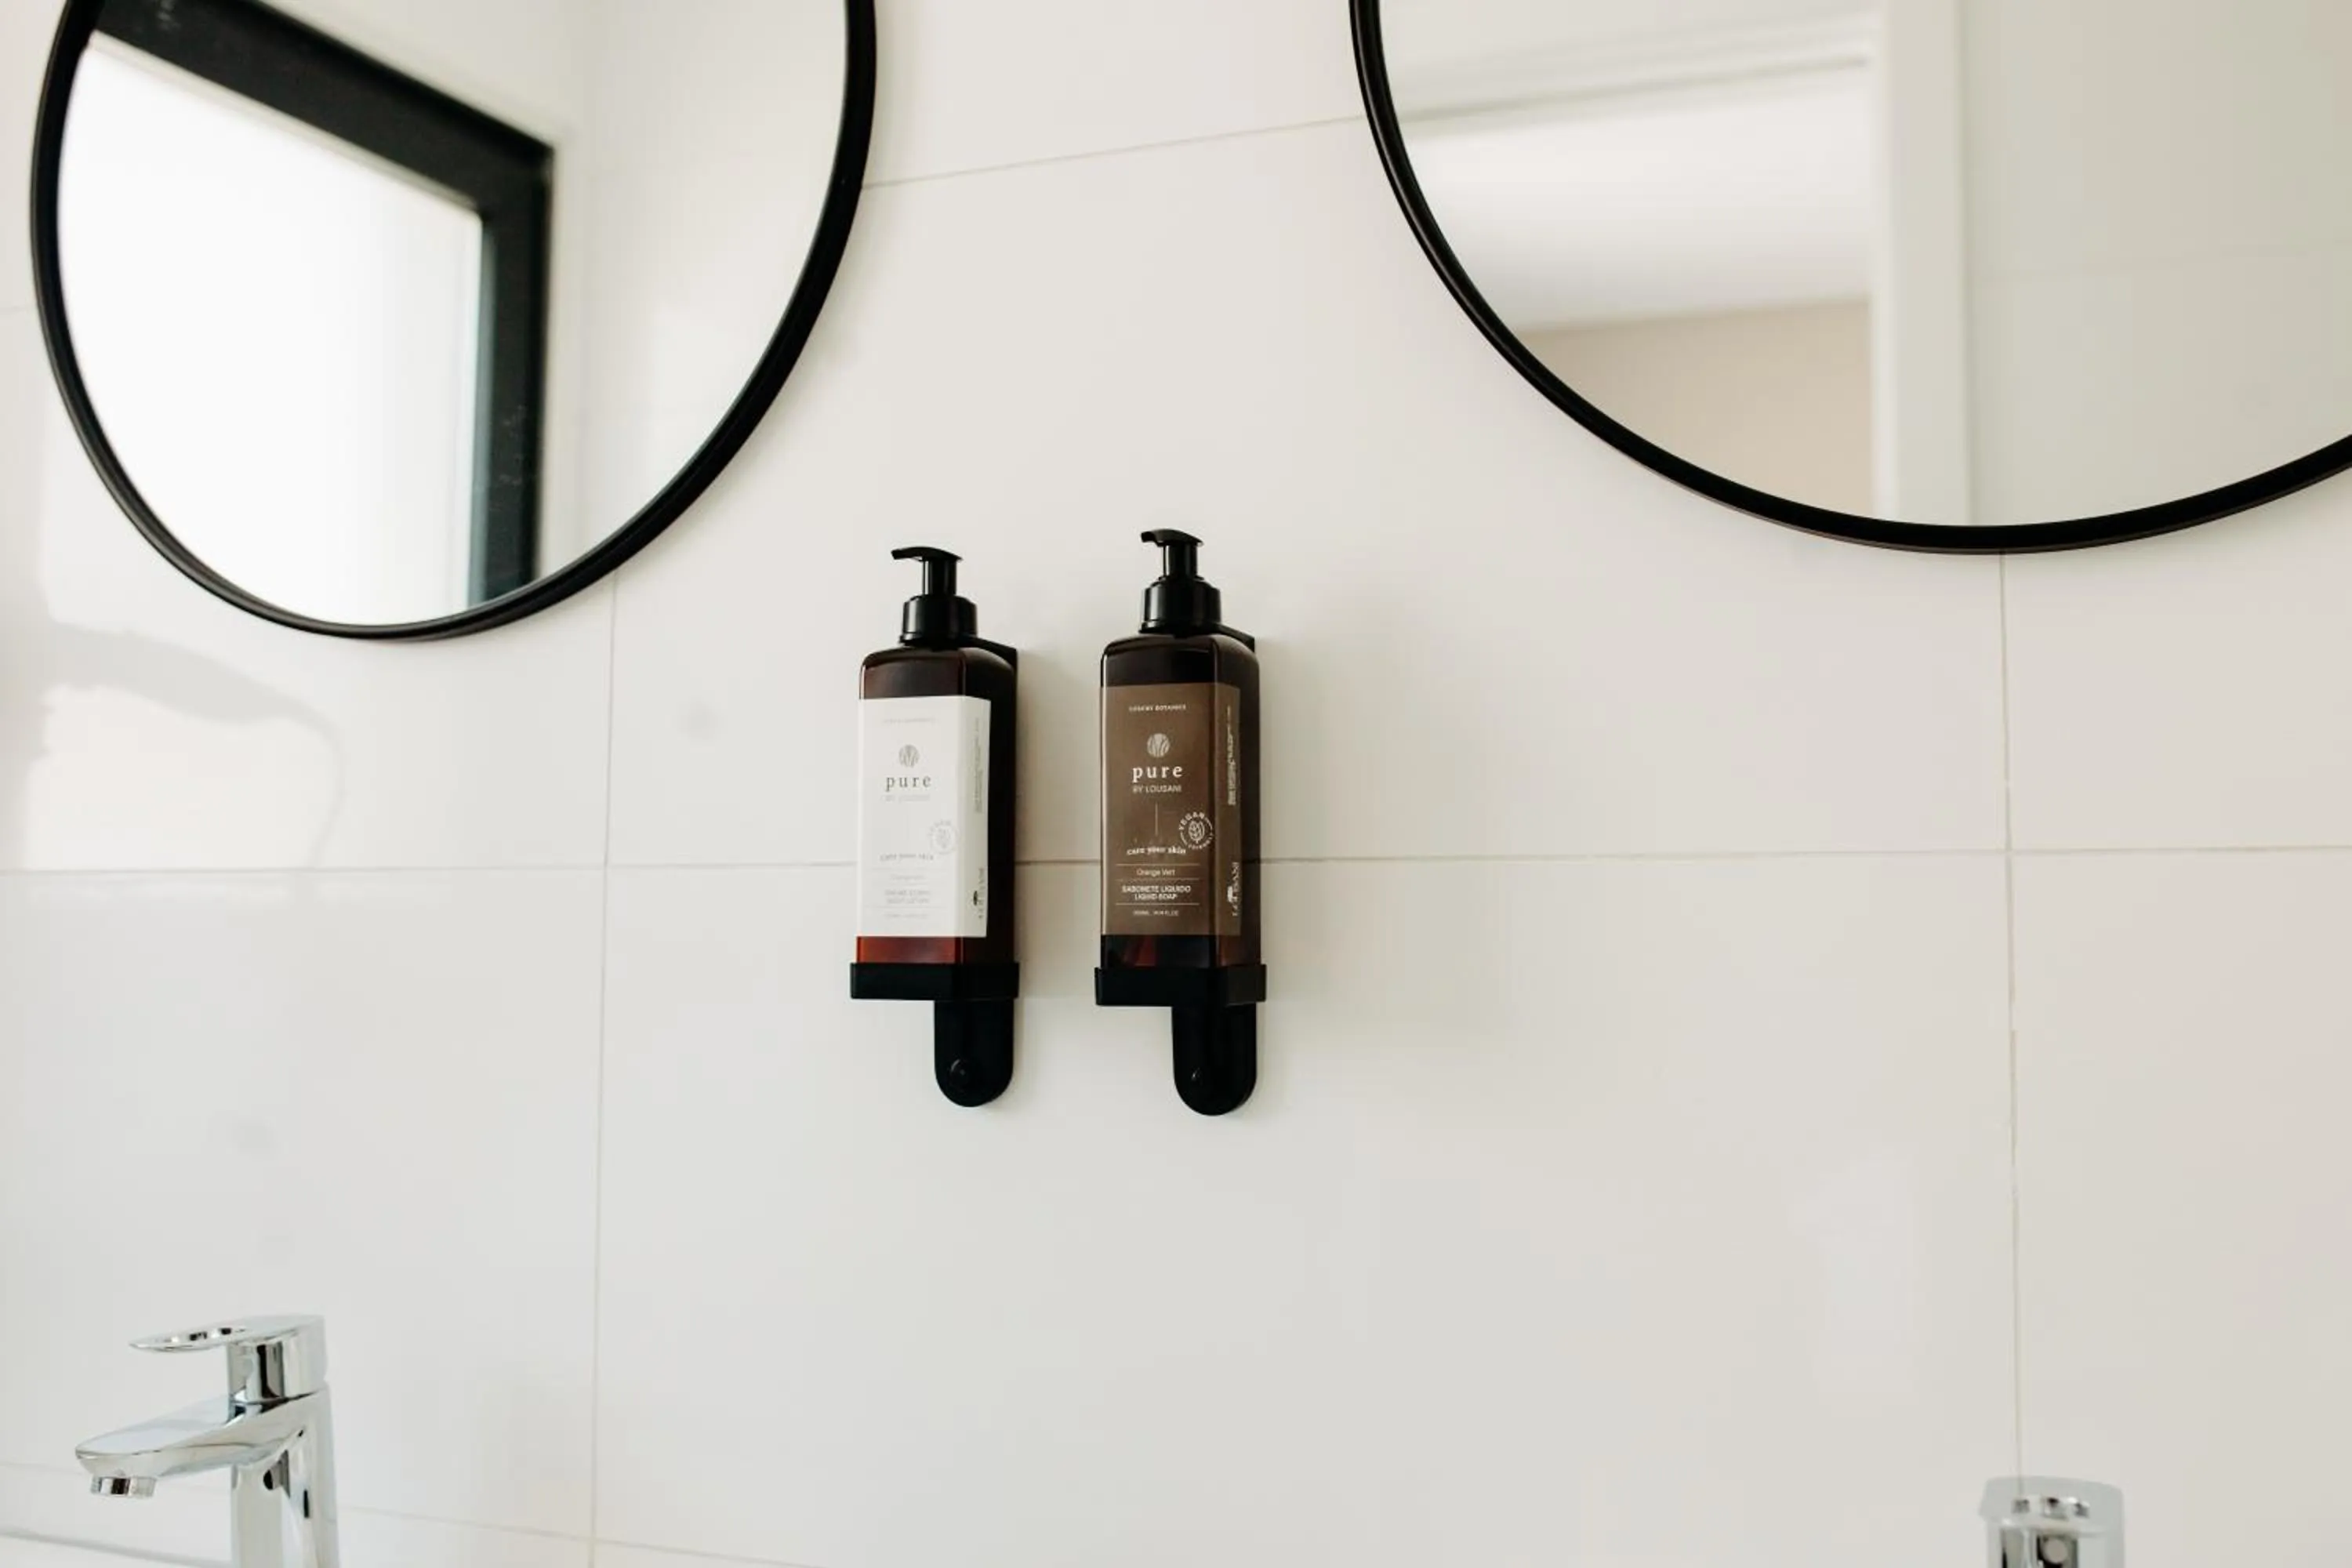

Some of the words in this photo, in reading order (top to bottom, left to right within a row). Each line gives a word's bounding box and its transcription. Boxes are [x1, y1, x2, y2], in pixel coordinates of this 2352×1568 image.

[1132, 765, 1183, 783] pure
[885, 775, 931, 793] pure
[1178, 811, 1206, 831] VEGAN
[1167, 846, 1186, 855] skin
[1136, 869, 1160, 877] Orange
